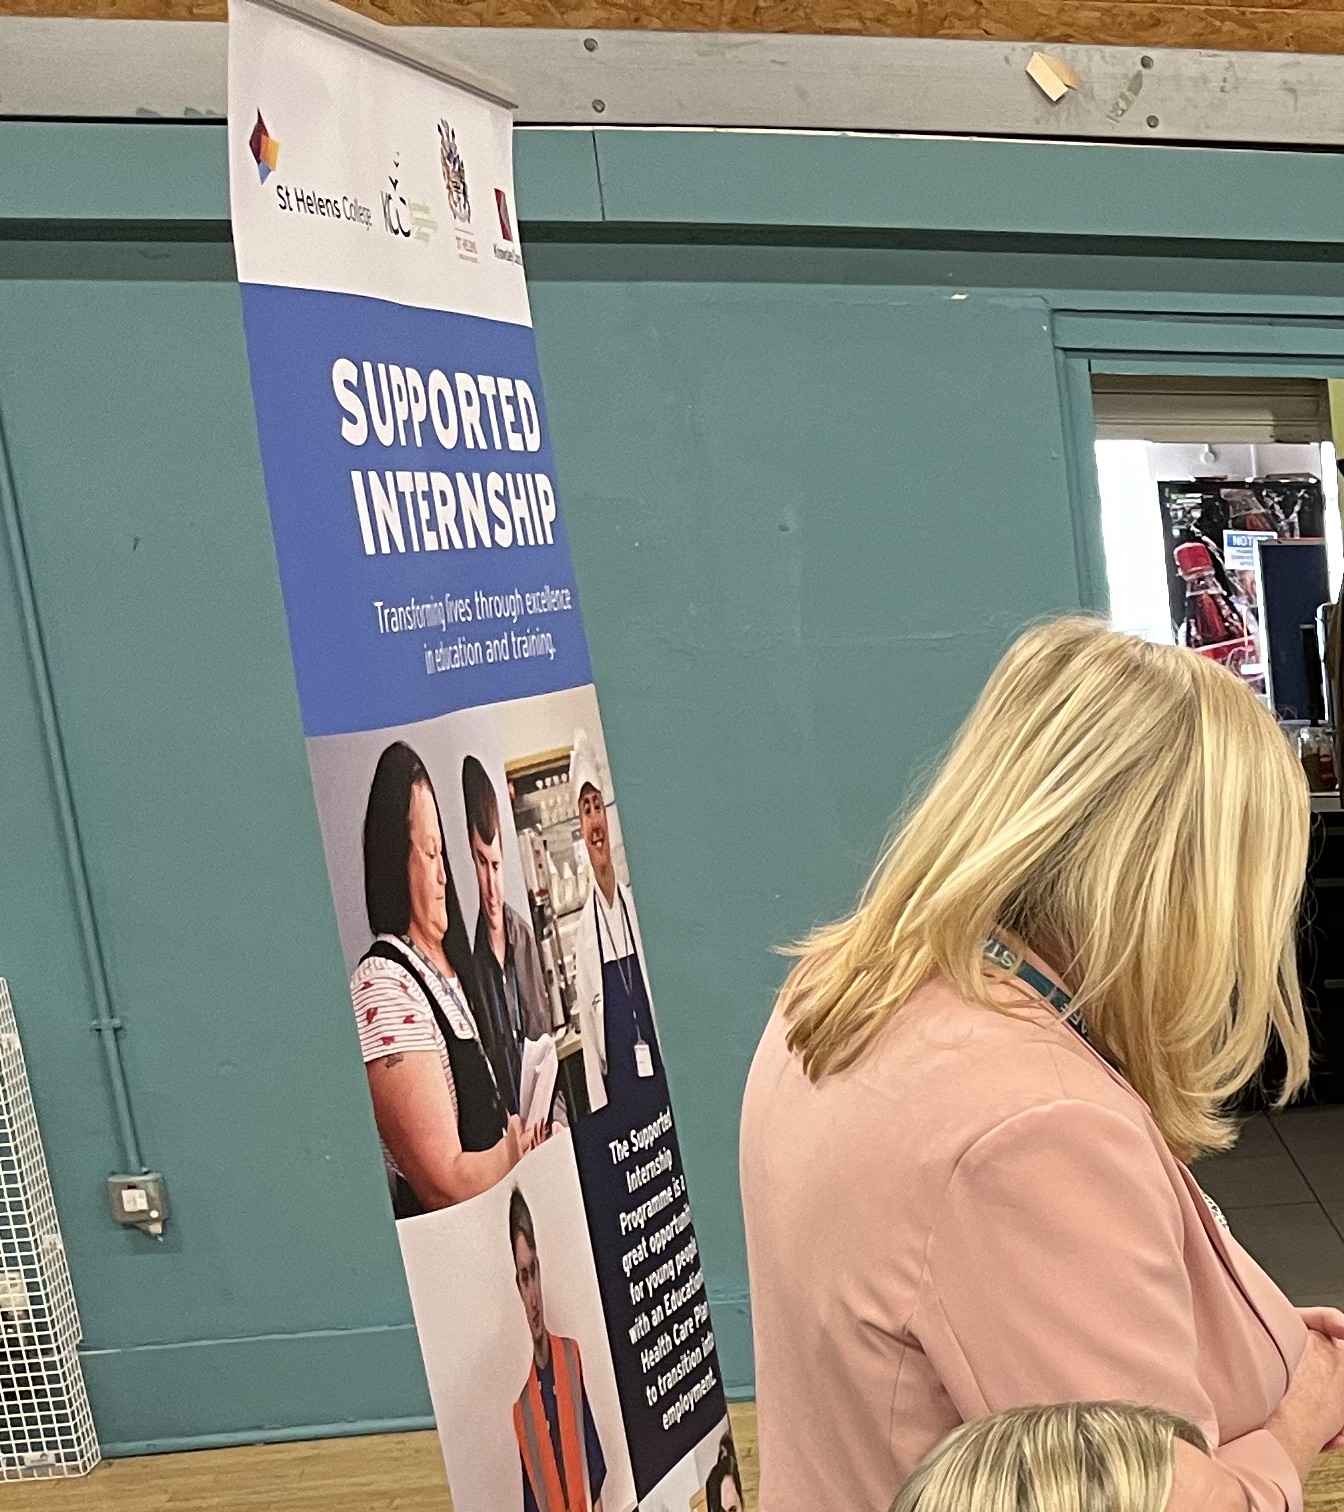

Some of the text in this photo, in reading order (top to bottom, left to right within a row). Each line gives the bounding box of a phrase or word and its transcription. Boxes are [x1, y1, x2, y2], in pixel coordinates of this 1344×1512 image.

[276, 184, 293, 212] St
[297, 187, 341, 220] Helens
[332, 358, 541, 452] SUPPORTED
[351, 470, 557, 555] INTERNSHIP
[374, 585, 572, 633] Transforming lives through excellence
[486, 637, 509, 662] and
[608, 1105, 673, 1164] The Supported
[626, 1147, 673, 1193] Internship
[619, 1176, 682, 1236] Programme is
[622, 1236, 648, 1277] great
[629, 1259, 676, 1306] for young
[628, 1312, 651, 1345] with
[651, 1304, 664, 1327] an
[641, 1315, 695, 1374] Health Care
[646, 1384, 657, 1407] to
[657, 1346, 702, 1397] transition
[662, 1366, 717, 1431] employment.
